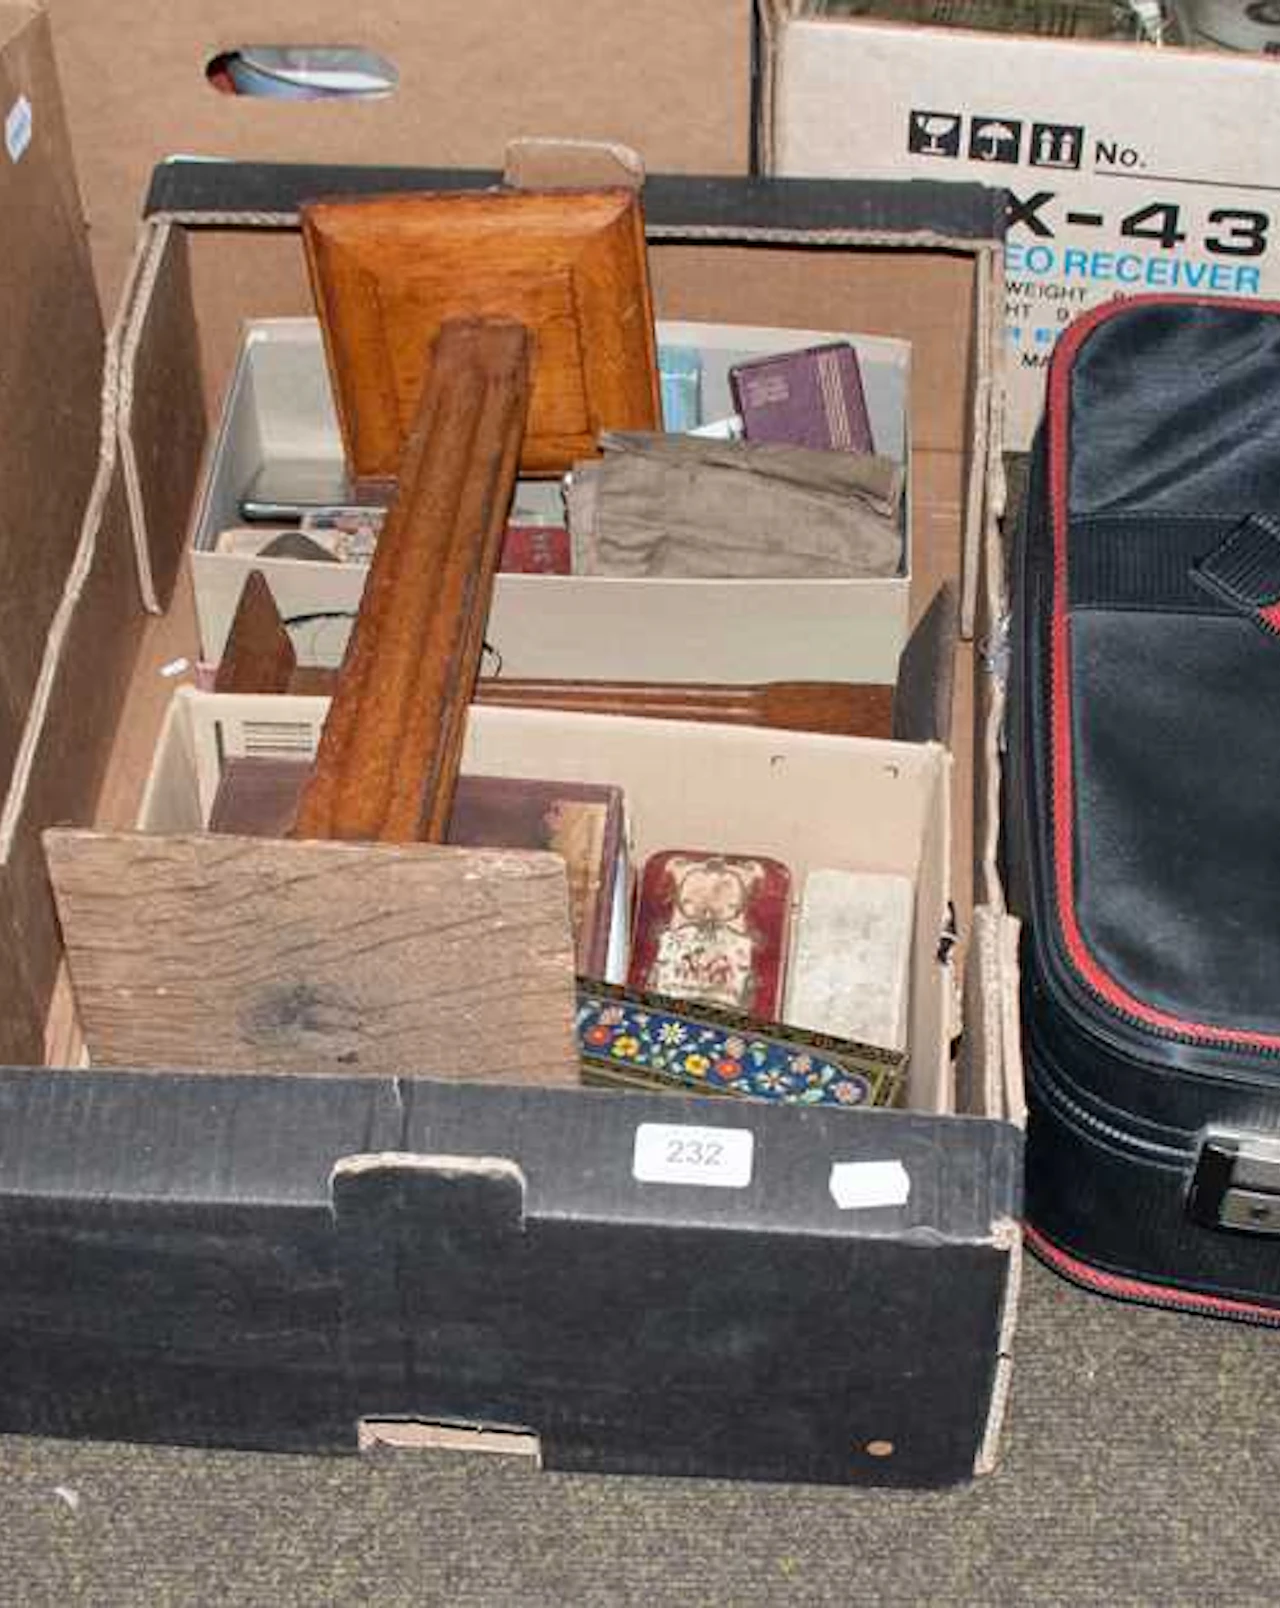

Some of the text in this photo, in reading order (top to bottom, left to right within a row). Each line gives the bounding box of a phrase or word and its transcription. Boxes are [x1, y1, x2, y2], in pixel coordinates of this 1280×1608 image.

[1094, 141, 1148, 168] No.
[1004, 244, 1261, 294] EO RECEIVER
[1004, 281, 1087, 303] WEIGHT
[1004, 303, 1033, 319] HT
[1021, 353, 1051, 369] MA
[665, 1139, 725, 1166] 232
